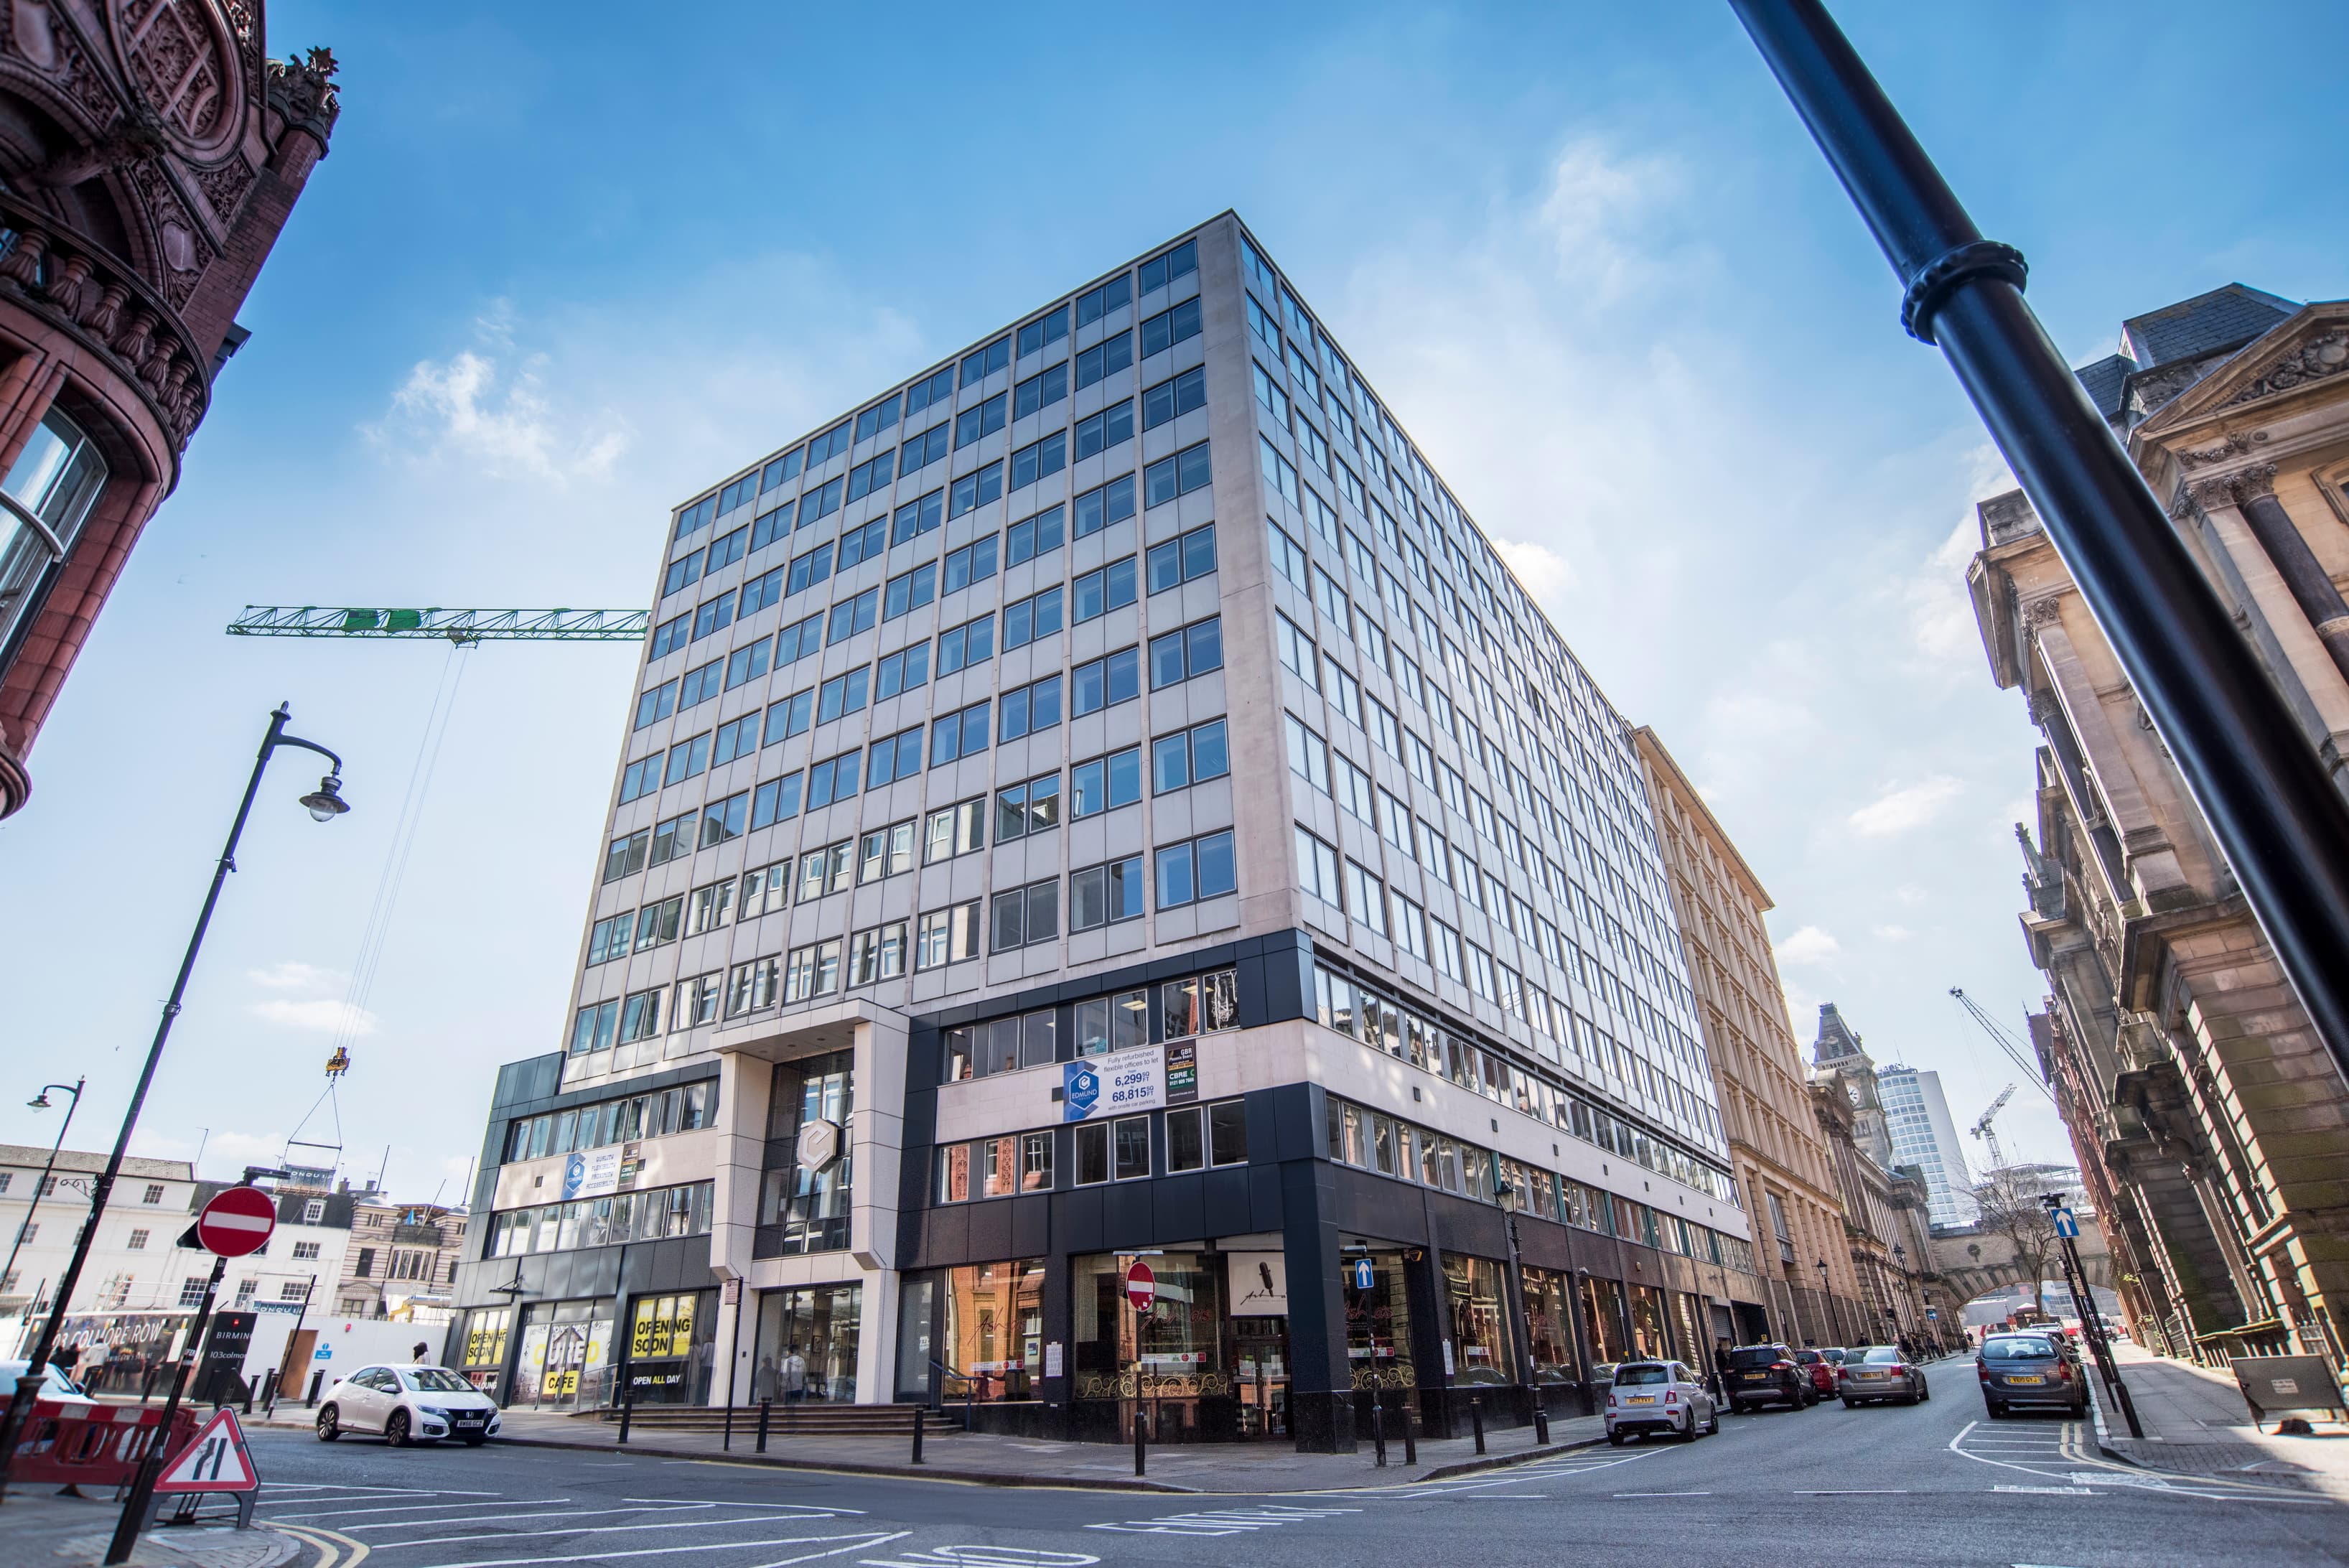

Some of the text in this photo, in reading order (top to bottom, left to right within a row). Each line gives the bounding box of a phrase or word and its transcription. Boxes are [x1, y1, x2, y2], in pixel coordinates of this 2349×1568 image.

[1122, 1050, 1154, 1062] refurbished
[1115, 1073, 1141, 1087] 6,299
[1169, 1070, 1187, 1079] CBRE
[1072, 1089, 1097, 1098] EDMUND
[1112, 1087, 1147, 1102] 68,815
[597, 1154, 614, 1162] QUALITY
[637, 1319, 691, 1335] OPENING
[70, 1325, 131, 1348] COLMORE
[131, 1322, 163, 1343] ROW
[634, 1338, 668, 1353] SOON
[468, 1346, 491, 1358] SOON
[548, 1376, 574, 1389] CAFE
[633, 1375, 681, 1385] OPEN ALL DAY
